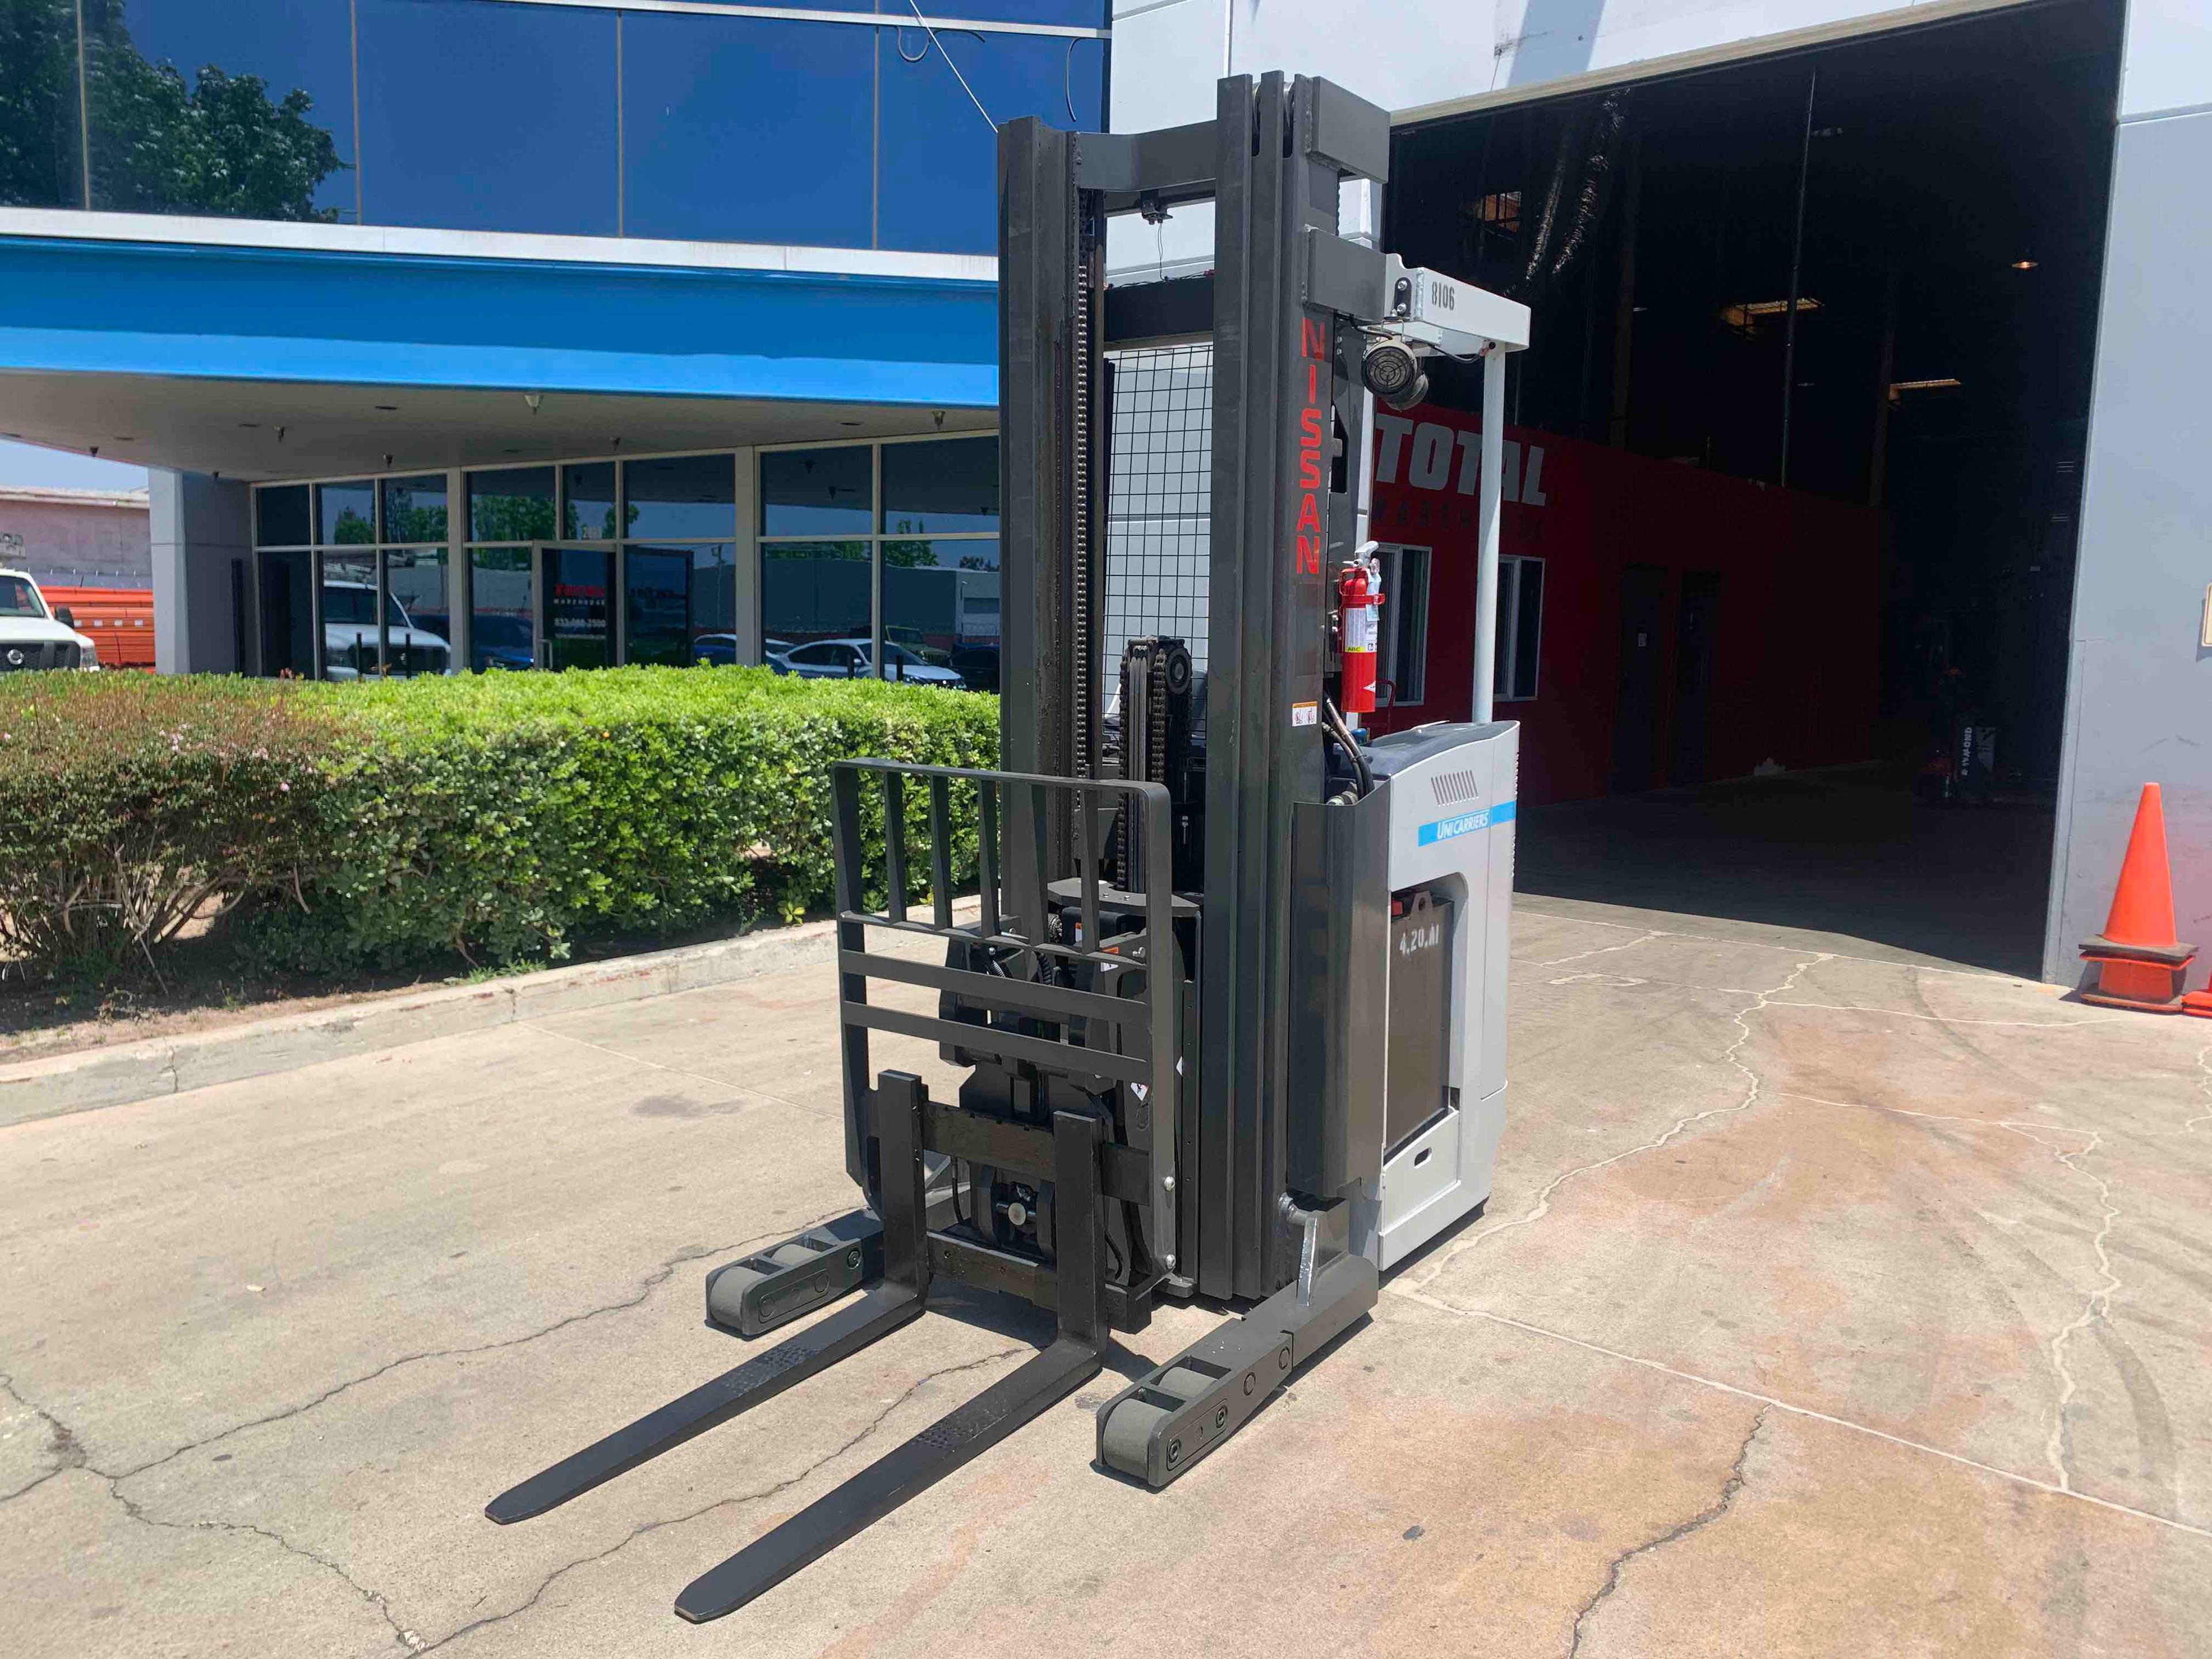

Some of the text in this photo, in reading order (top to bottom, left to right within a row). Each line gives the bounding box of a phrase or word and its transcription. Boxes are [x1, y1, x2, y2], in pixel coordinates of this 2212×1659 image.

[1432, 281, 1455, 310] 8106
[1296, 318, 1325, 574] NISSAN
[1961, 727, 1973, 776] RAYMOND
